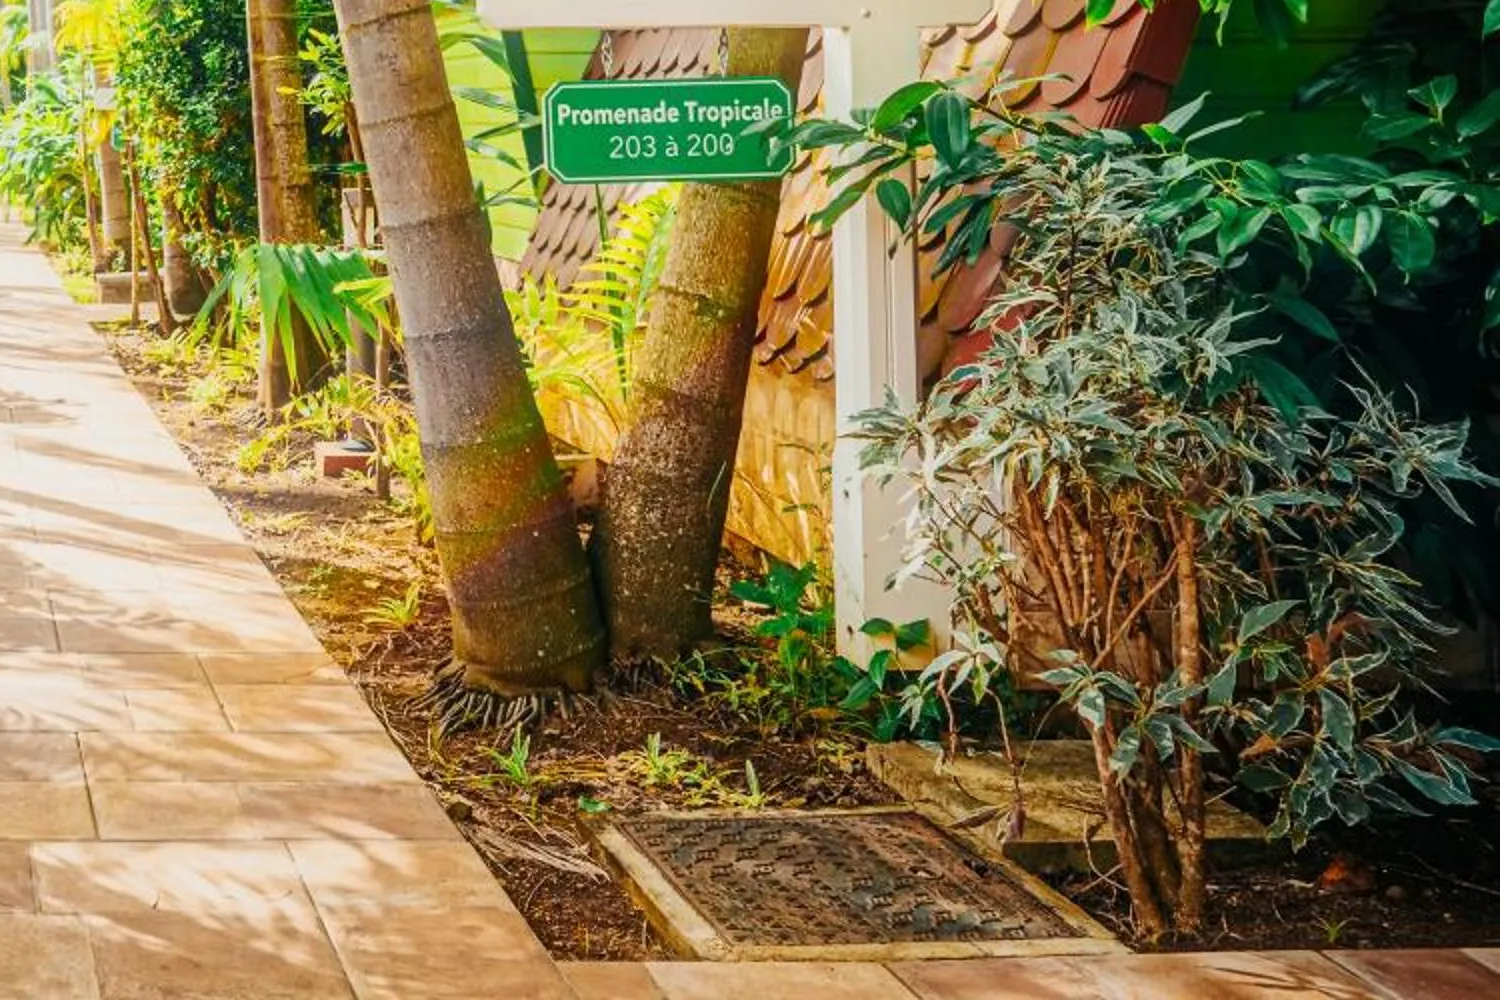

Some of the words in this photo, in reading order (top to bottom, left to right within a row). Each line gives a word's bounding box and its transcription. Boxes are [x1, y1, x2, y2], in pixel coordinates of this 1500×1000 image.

[557, 101, 680, 126] Promenade
[684, 97, 783, 128] Tropicale
[609, 136, 657, 159] 203
[665, 136, 679, 158] à
